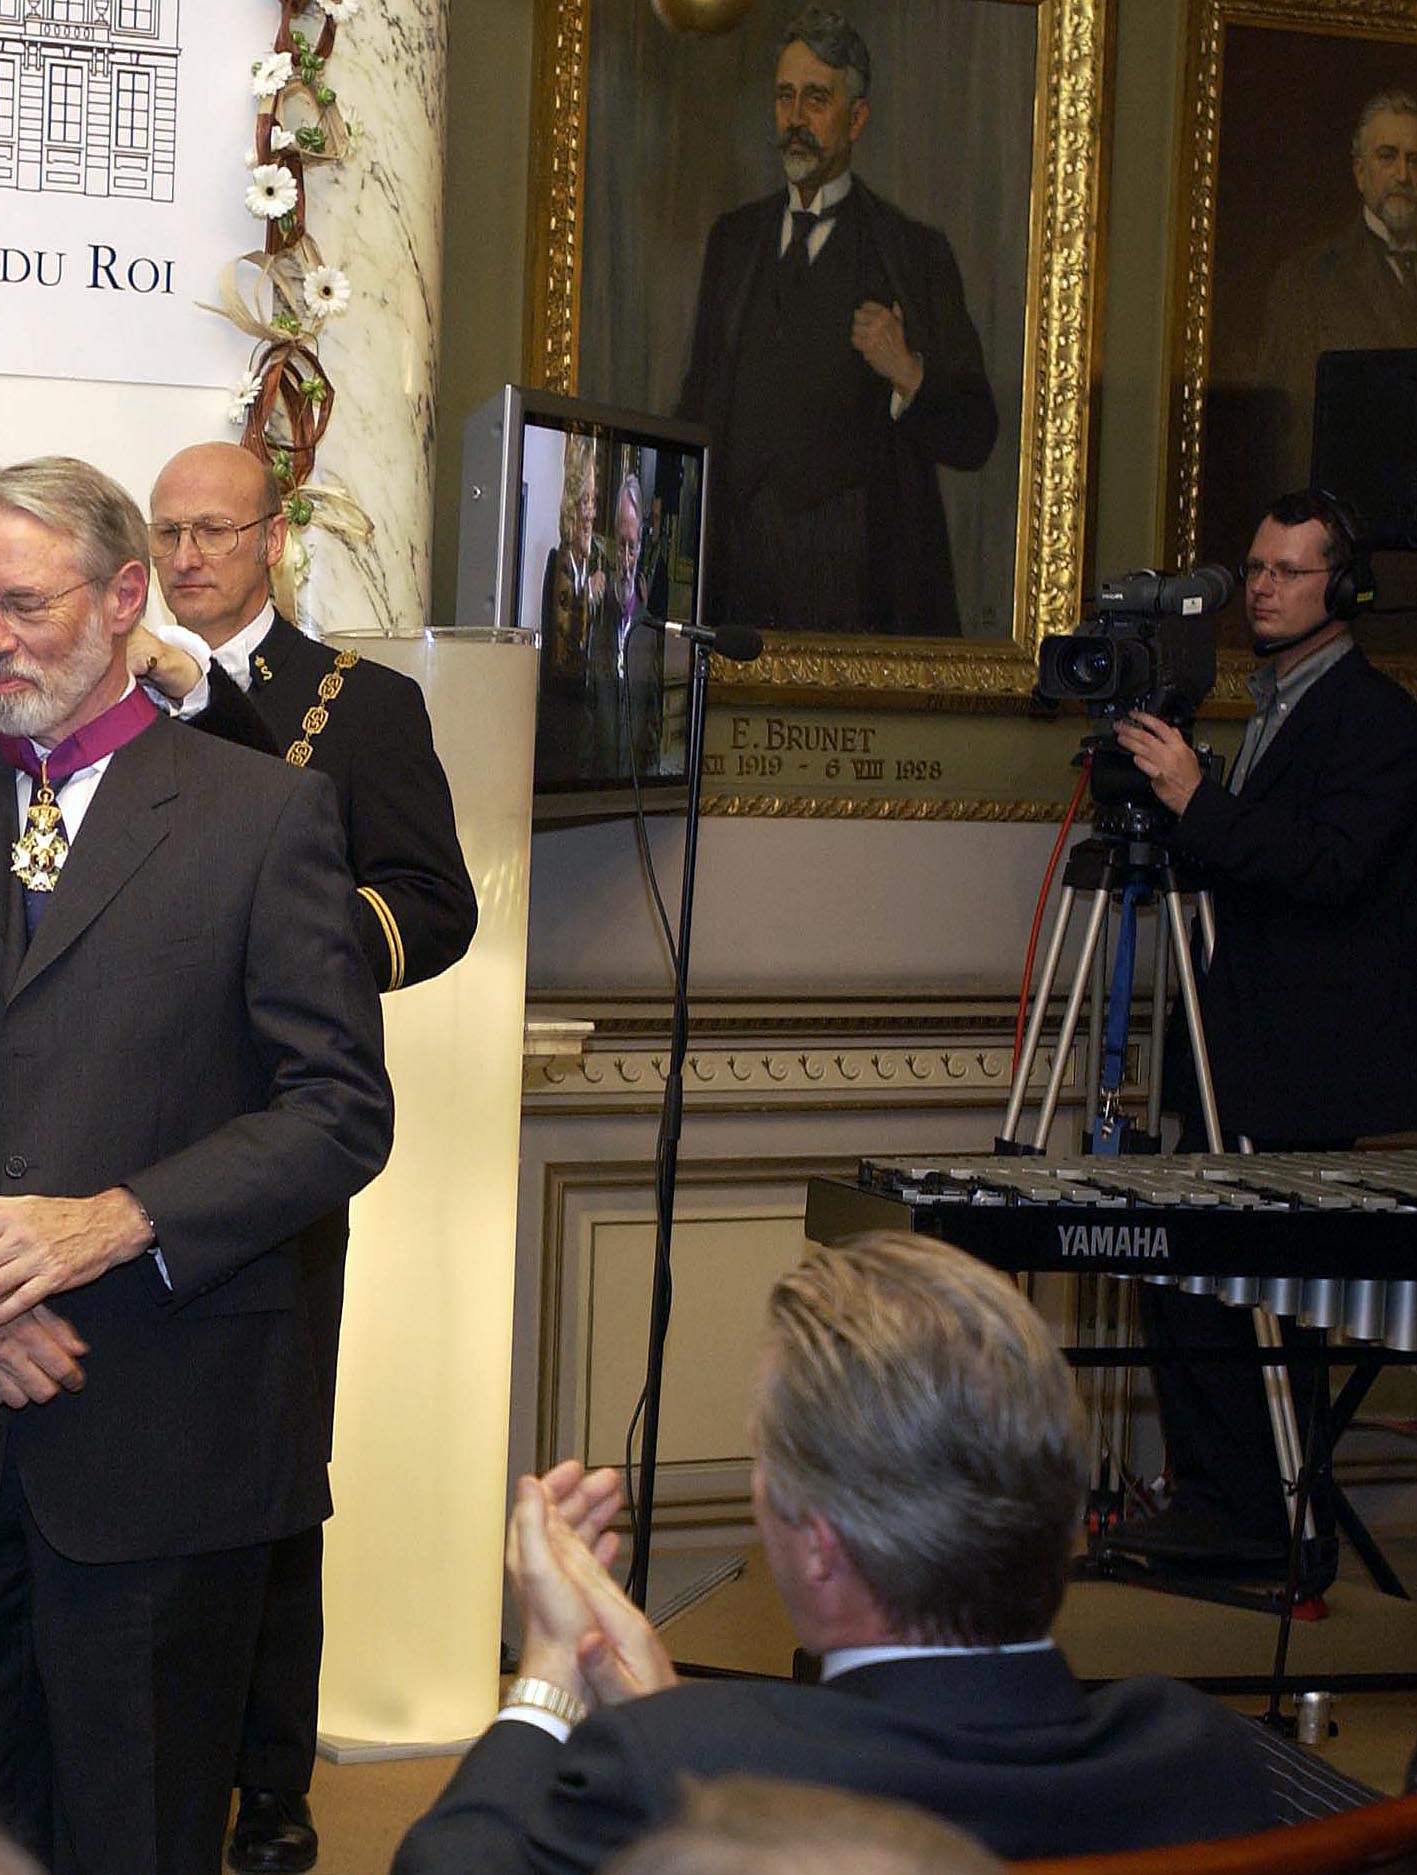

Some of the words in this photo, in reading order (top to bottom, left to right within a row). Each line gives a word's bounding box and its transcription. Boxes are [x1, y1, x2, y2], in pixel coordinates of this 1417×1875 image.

[0, 248, 66, 287] DU
[86, 244, 176, 295] ROI
[731, 717, 759, 750] E.
[764, 717, 877, 753] BRUNET
[735, 754, 783, 777] 1919
[824, 757, 841, 780] 6
[850, 757, 885, 780] VIII
[894, 759, 943, 781] 1928
[1057, 1224, 1170, 1259] YAMAHA
